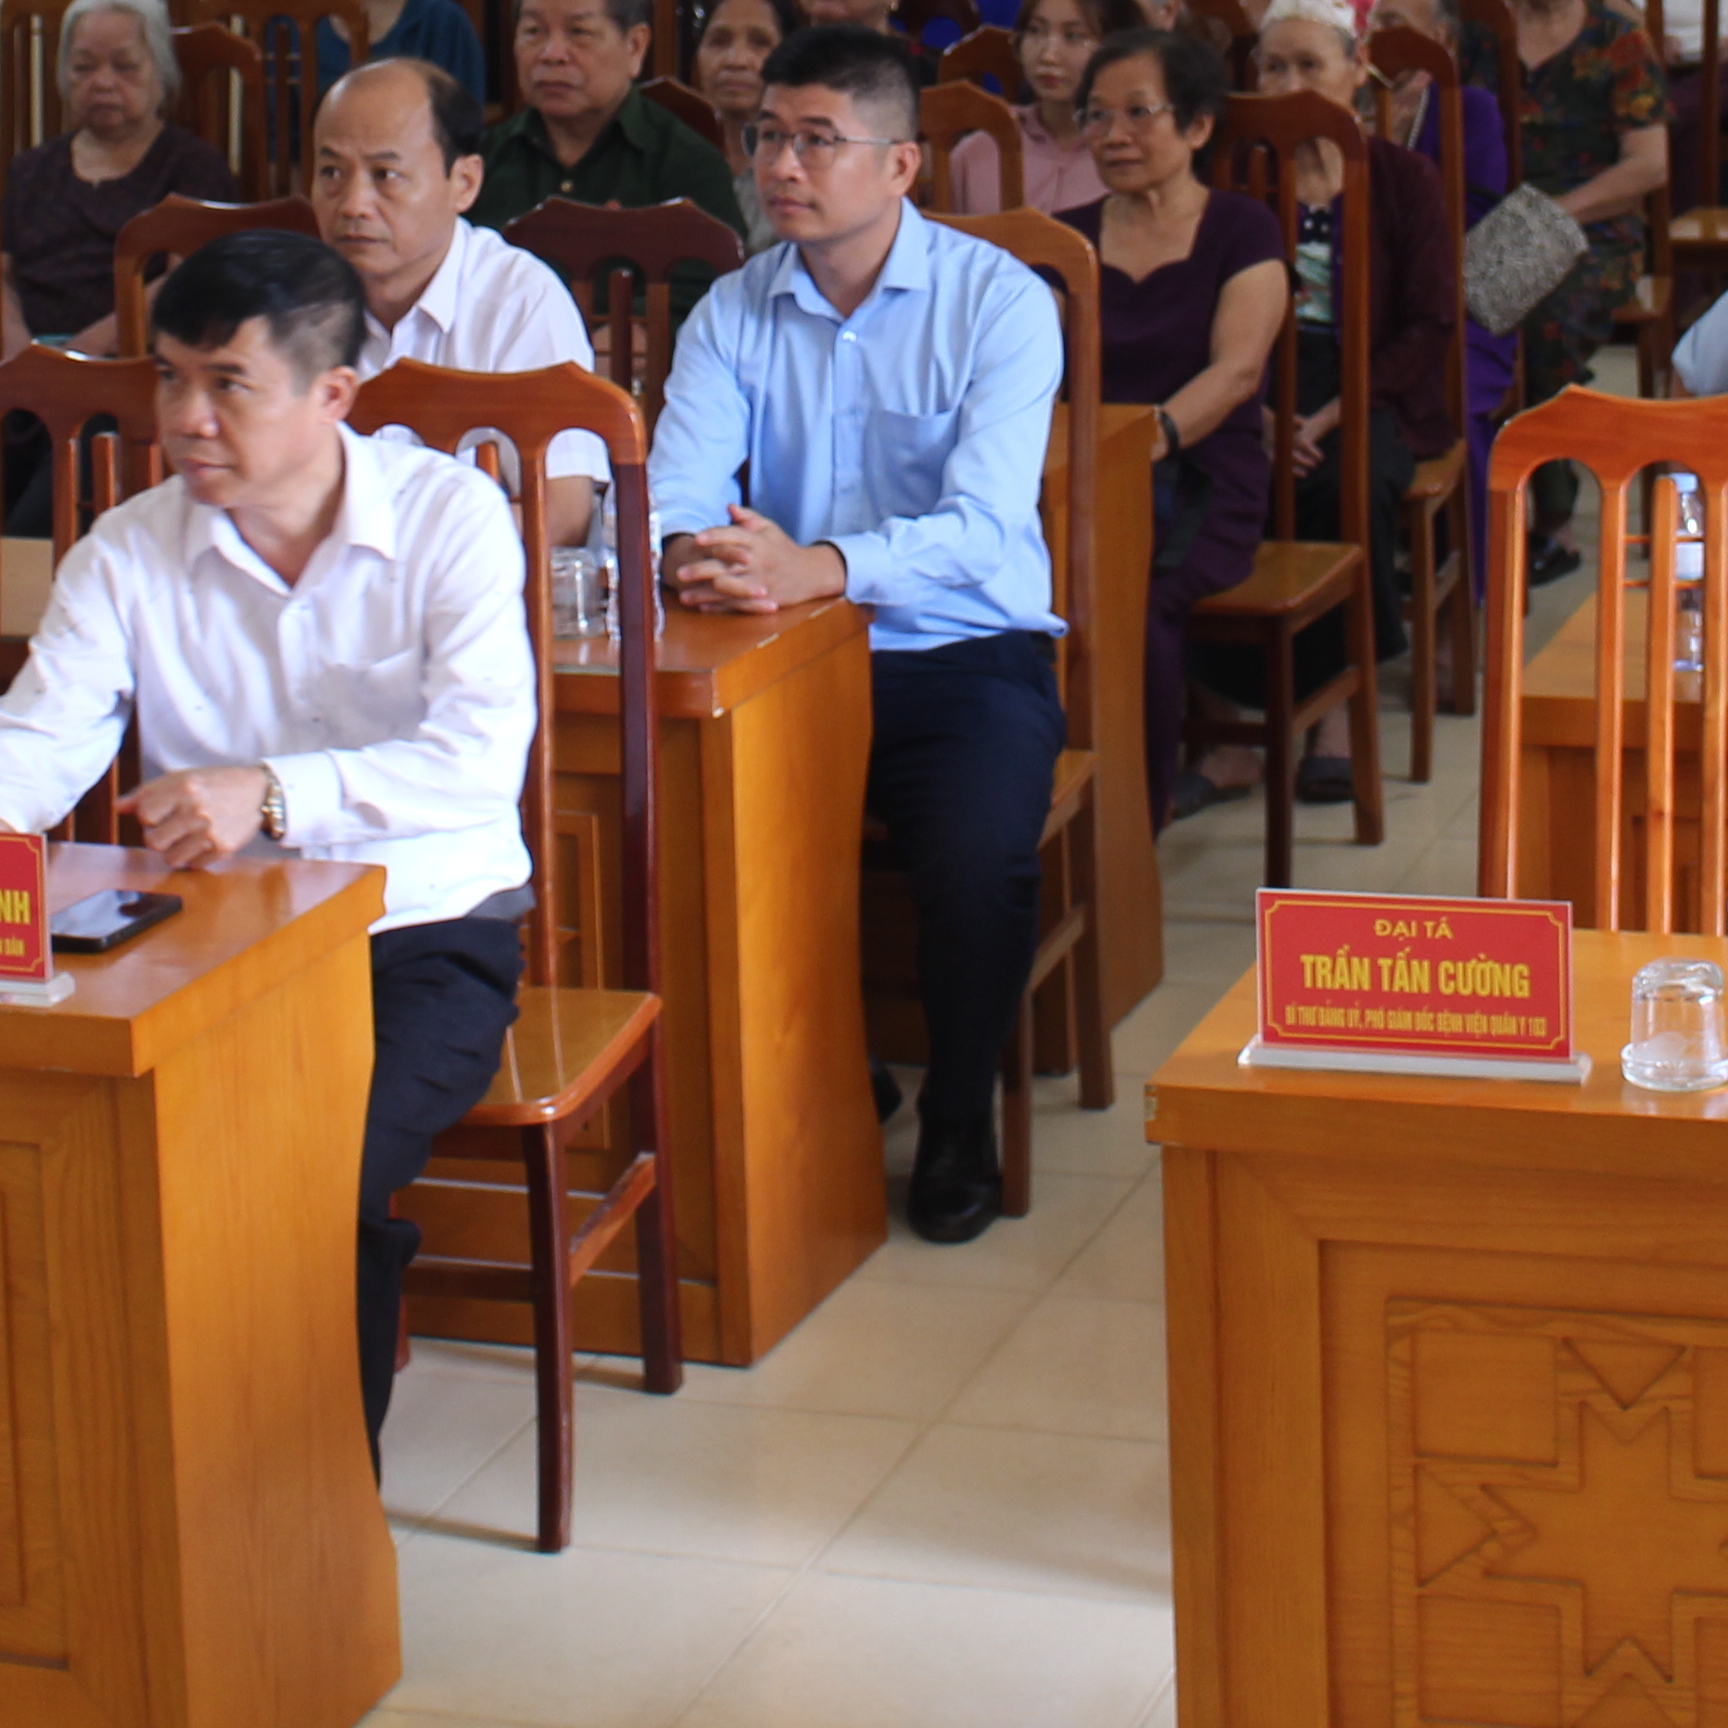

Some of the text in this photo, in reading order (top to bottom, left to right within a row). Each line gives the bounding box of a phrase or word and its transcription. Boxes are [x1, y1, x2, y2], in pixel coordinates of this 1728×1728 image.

[1374, 916, 1454, 941] ĐẠI TÁ
[1300, 944, 1530, 999] TRẦN TẤN CƯỜNG
